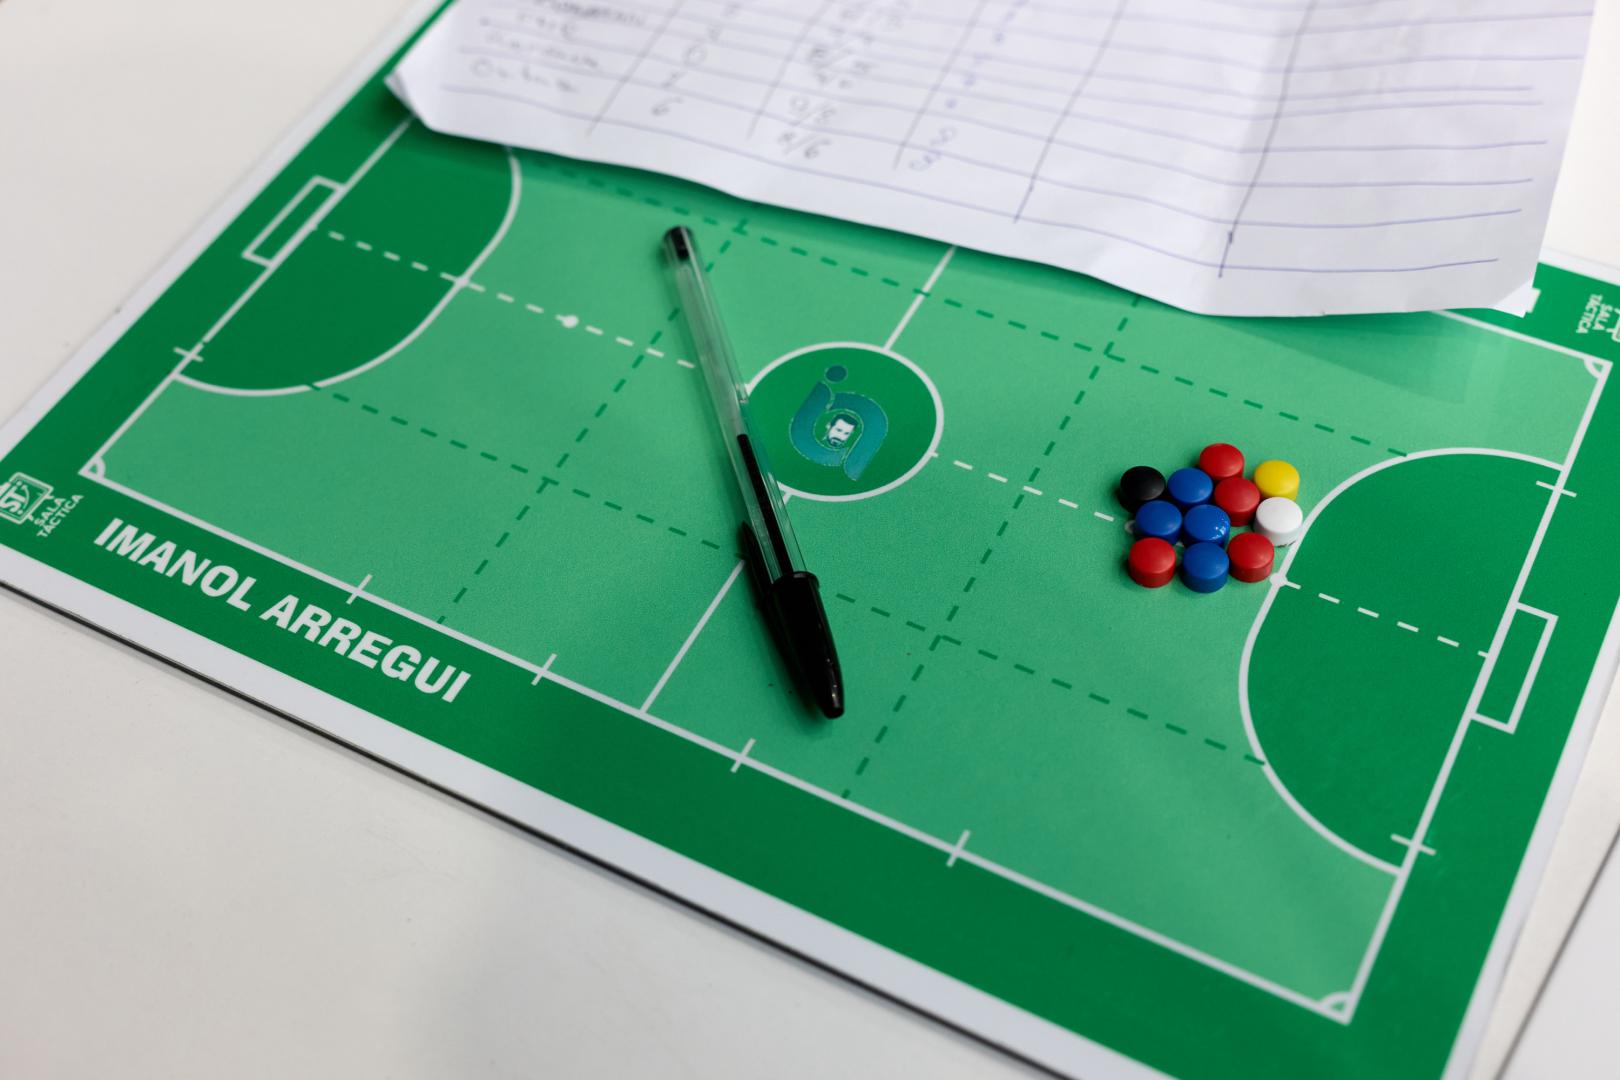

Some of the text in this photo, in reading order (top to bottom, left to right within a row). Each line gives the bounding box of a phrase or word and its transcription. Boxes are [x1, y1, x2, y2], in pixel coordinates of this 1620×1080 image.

[34, 498, 67, 526] SALA
[94, 517, 472, 703] IMANOL ARREGUI
